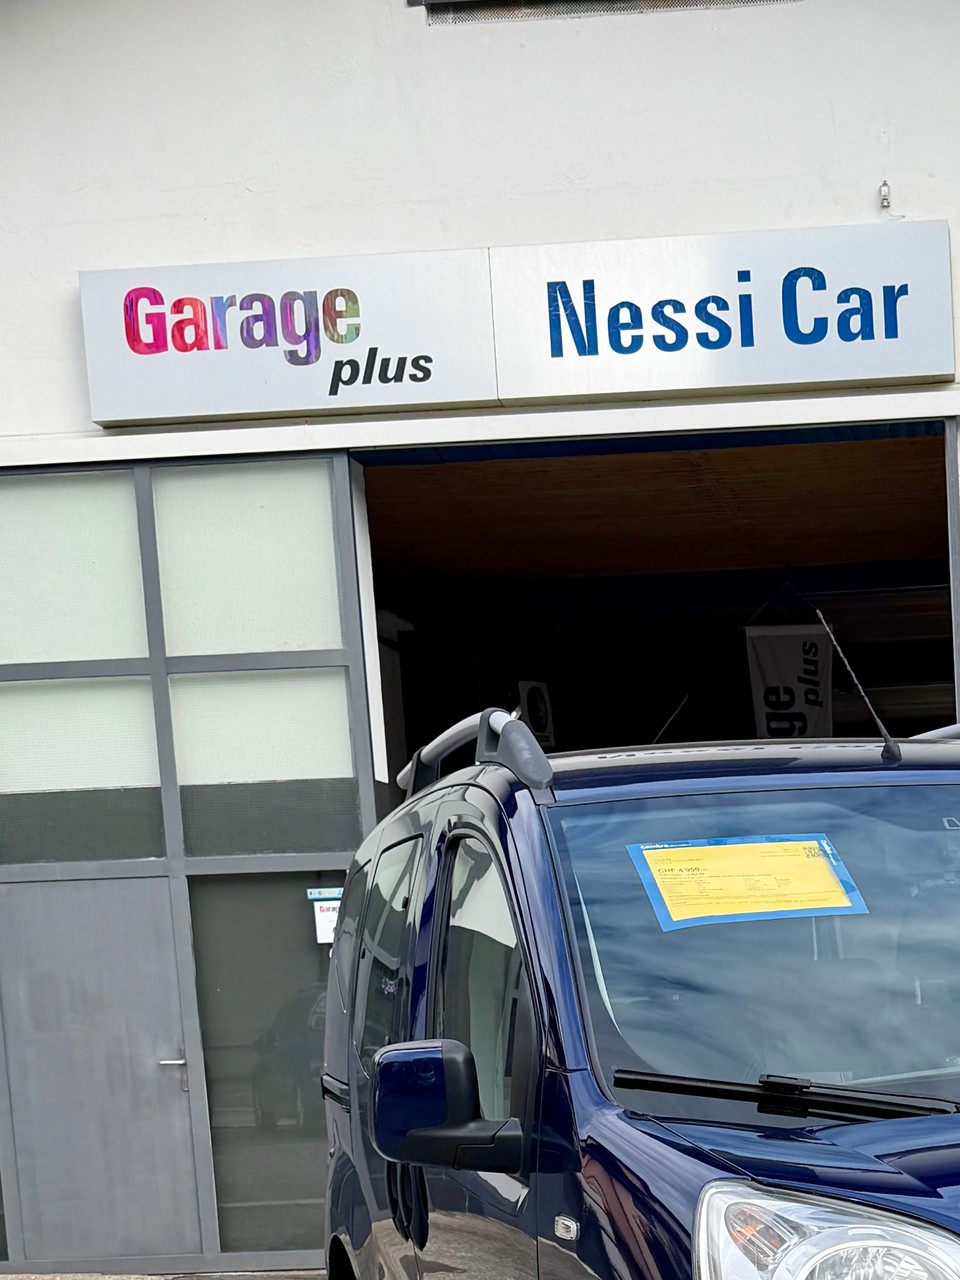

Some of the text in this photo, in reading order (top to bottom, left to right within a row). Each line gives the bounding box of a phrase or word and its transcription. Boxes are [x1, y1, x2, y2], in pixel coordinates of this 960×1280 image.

[122, 286, 360, 366] Garage
[547, 266, 910, 359] Nessi Car
[328, 346, 434, 396] plus
[797, 640, 823, 708] plus
